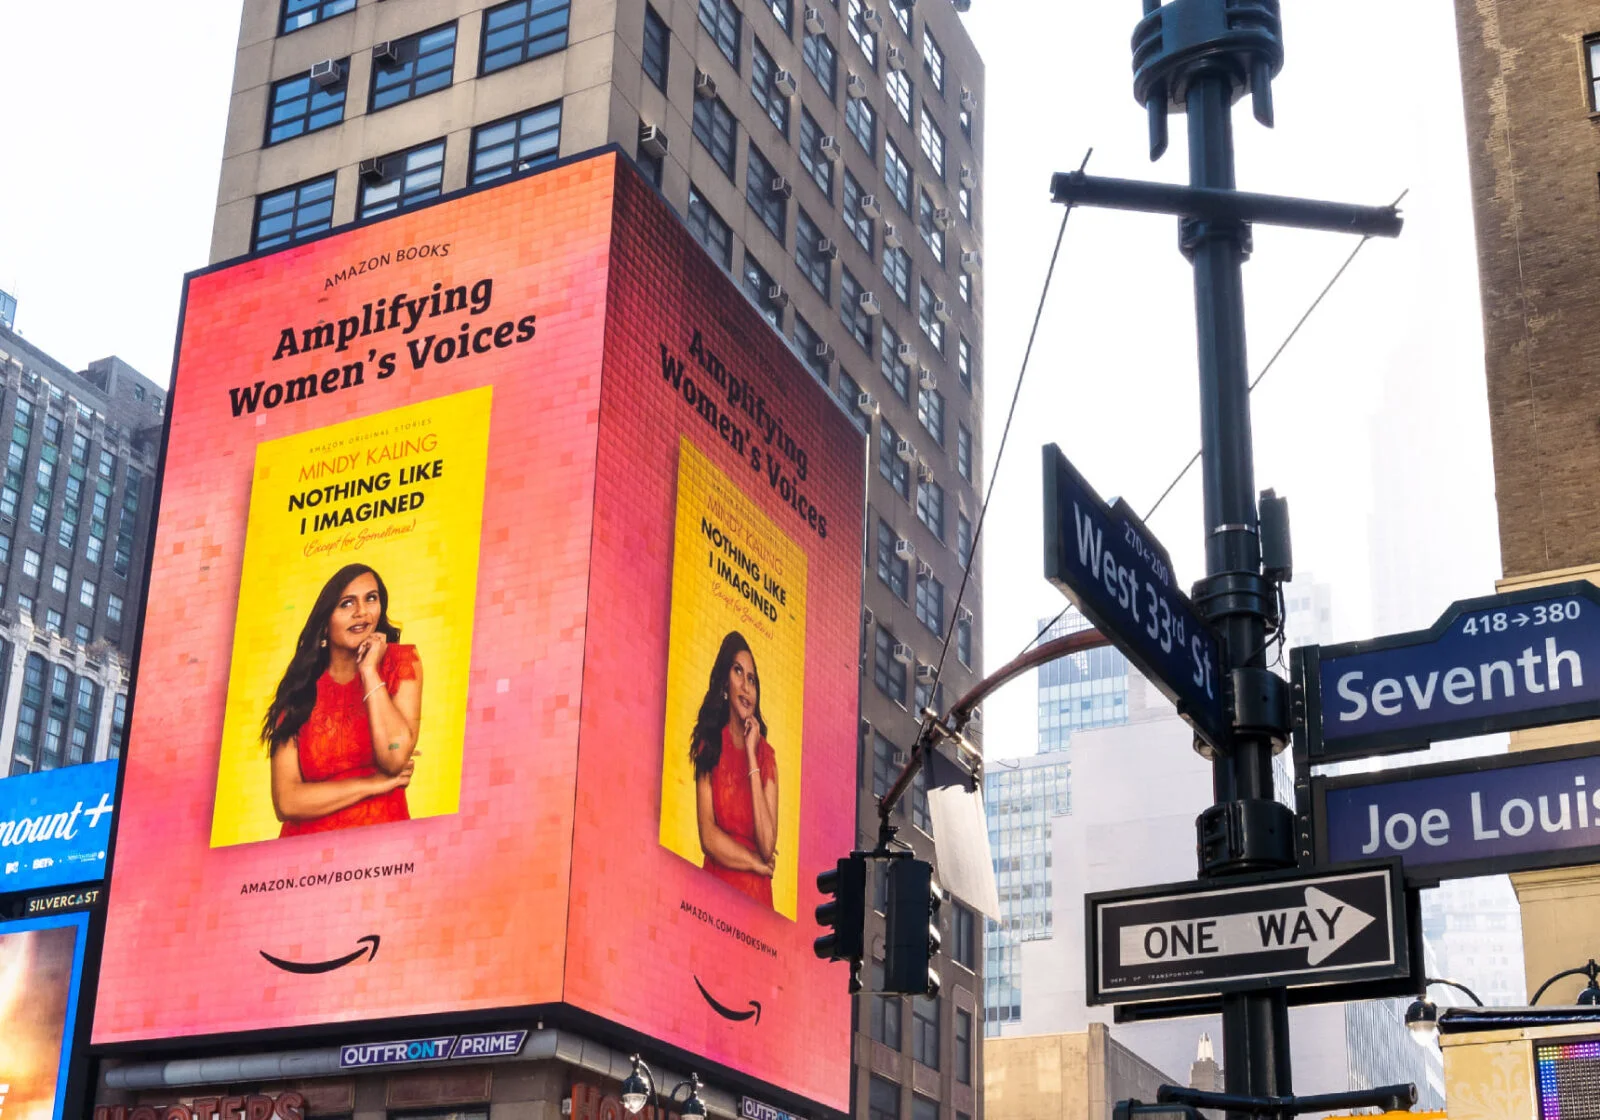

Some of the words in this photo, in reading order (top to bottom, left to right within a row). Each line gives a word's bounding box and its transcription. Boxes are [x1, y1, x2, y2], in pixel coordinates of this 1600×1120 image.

[324, 253, 391, 291] AMAZON
[395, 243, 451, 263] BOOKS
[272, 277, 493, 361] Amplifying
[228, 349, 397, 418] Women's
[407, 314, 537, 370] Voices
[688, 326, 808, 482] Amplifying
[298, 452, 361, 482] MINDY
[366, 433, 438, 467] KALING
[660, 342, 762, 473] Women's
[765, 450, 828, 539] Voices
[288, 472, 391, 512] NOTHING
[399, 459, 444, 486] LIKE
[300, 518, 307, 535] I
[313, 491, 425, 532] IMAGINED
[701, 516, 760, 582] NOTHING
[763, 573, 786, 607] LIKE
[1123, 520, 1143, 560] 270
[709, 551, 713, 568] I
[717, 558, 778, 623] IMAGINED
[1074, 500, 1140, 624] West
[1146, 582, 1185, 653] 33rd
[1191, 635, 1214, 700] St
[1463, 613, 1509, 636] 418
[1533, 601, 1581, 626] 380
[1337, 637, 1584, 722] Seventh
[1362, 805, 1450, 855] Joe
[29, 890, 99, 912] SILVERCAST
[240, 862, 414, 895] AMAZON.COM/BOOKSWHM
[680, 900, 777, 959] AMAZON.COM/BOOKSWHM
[1144, 921, 1219, 959] ONE
[1257, 906, 1344, 947] WAY
[344, 1039, 449, 1064] OUTFRONT
[461, 1034, 518, 1054] PRIME
[745, 1100, 797, 1120] OUTFRO
